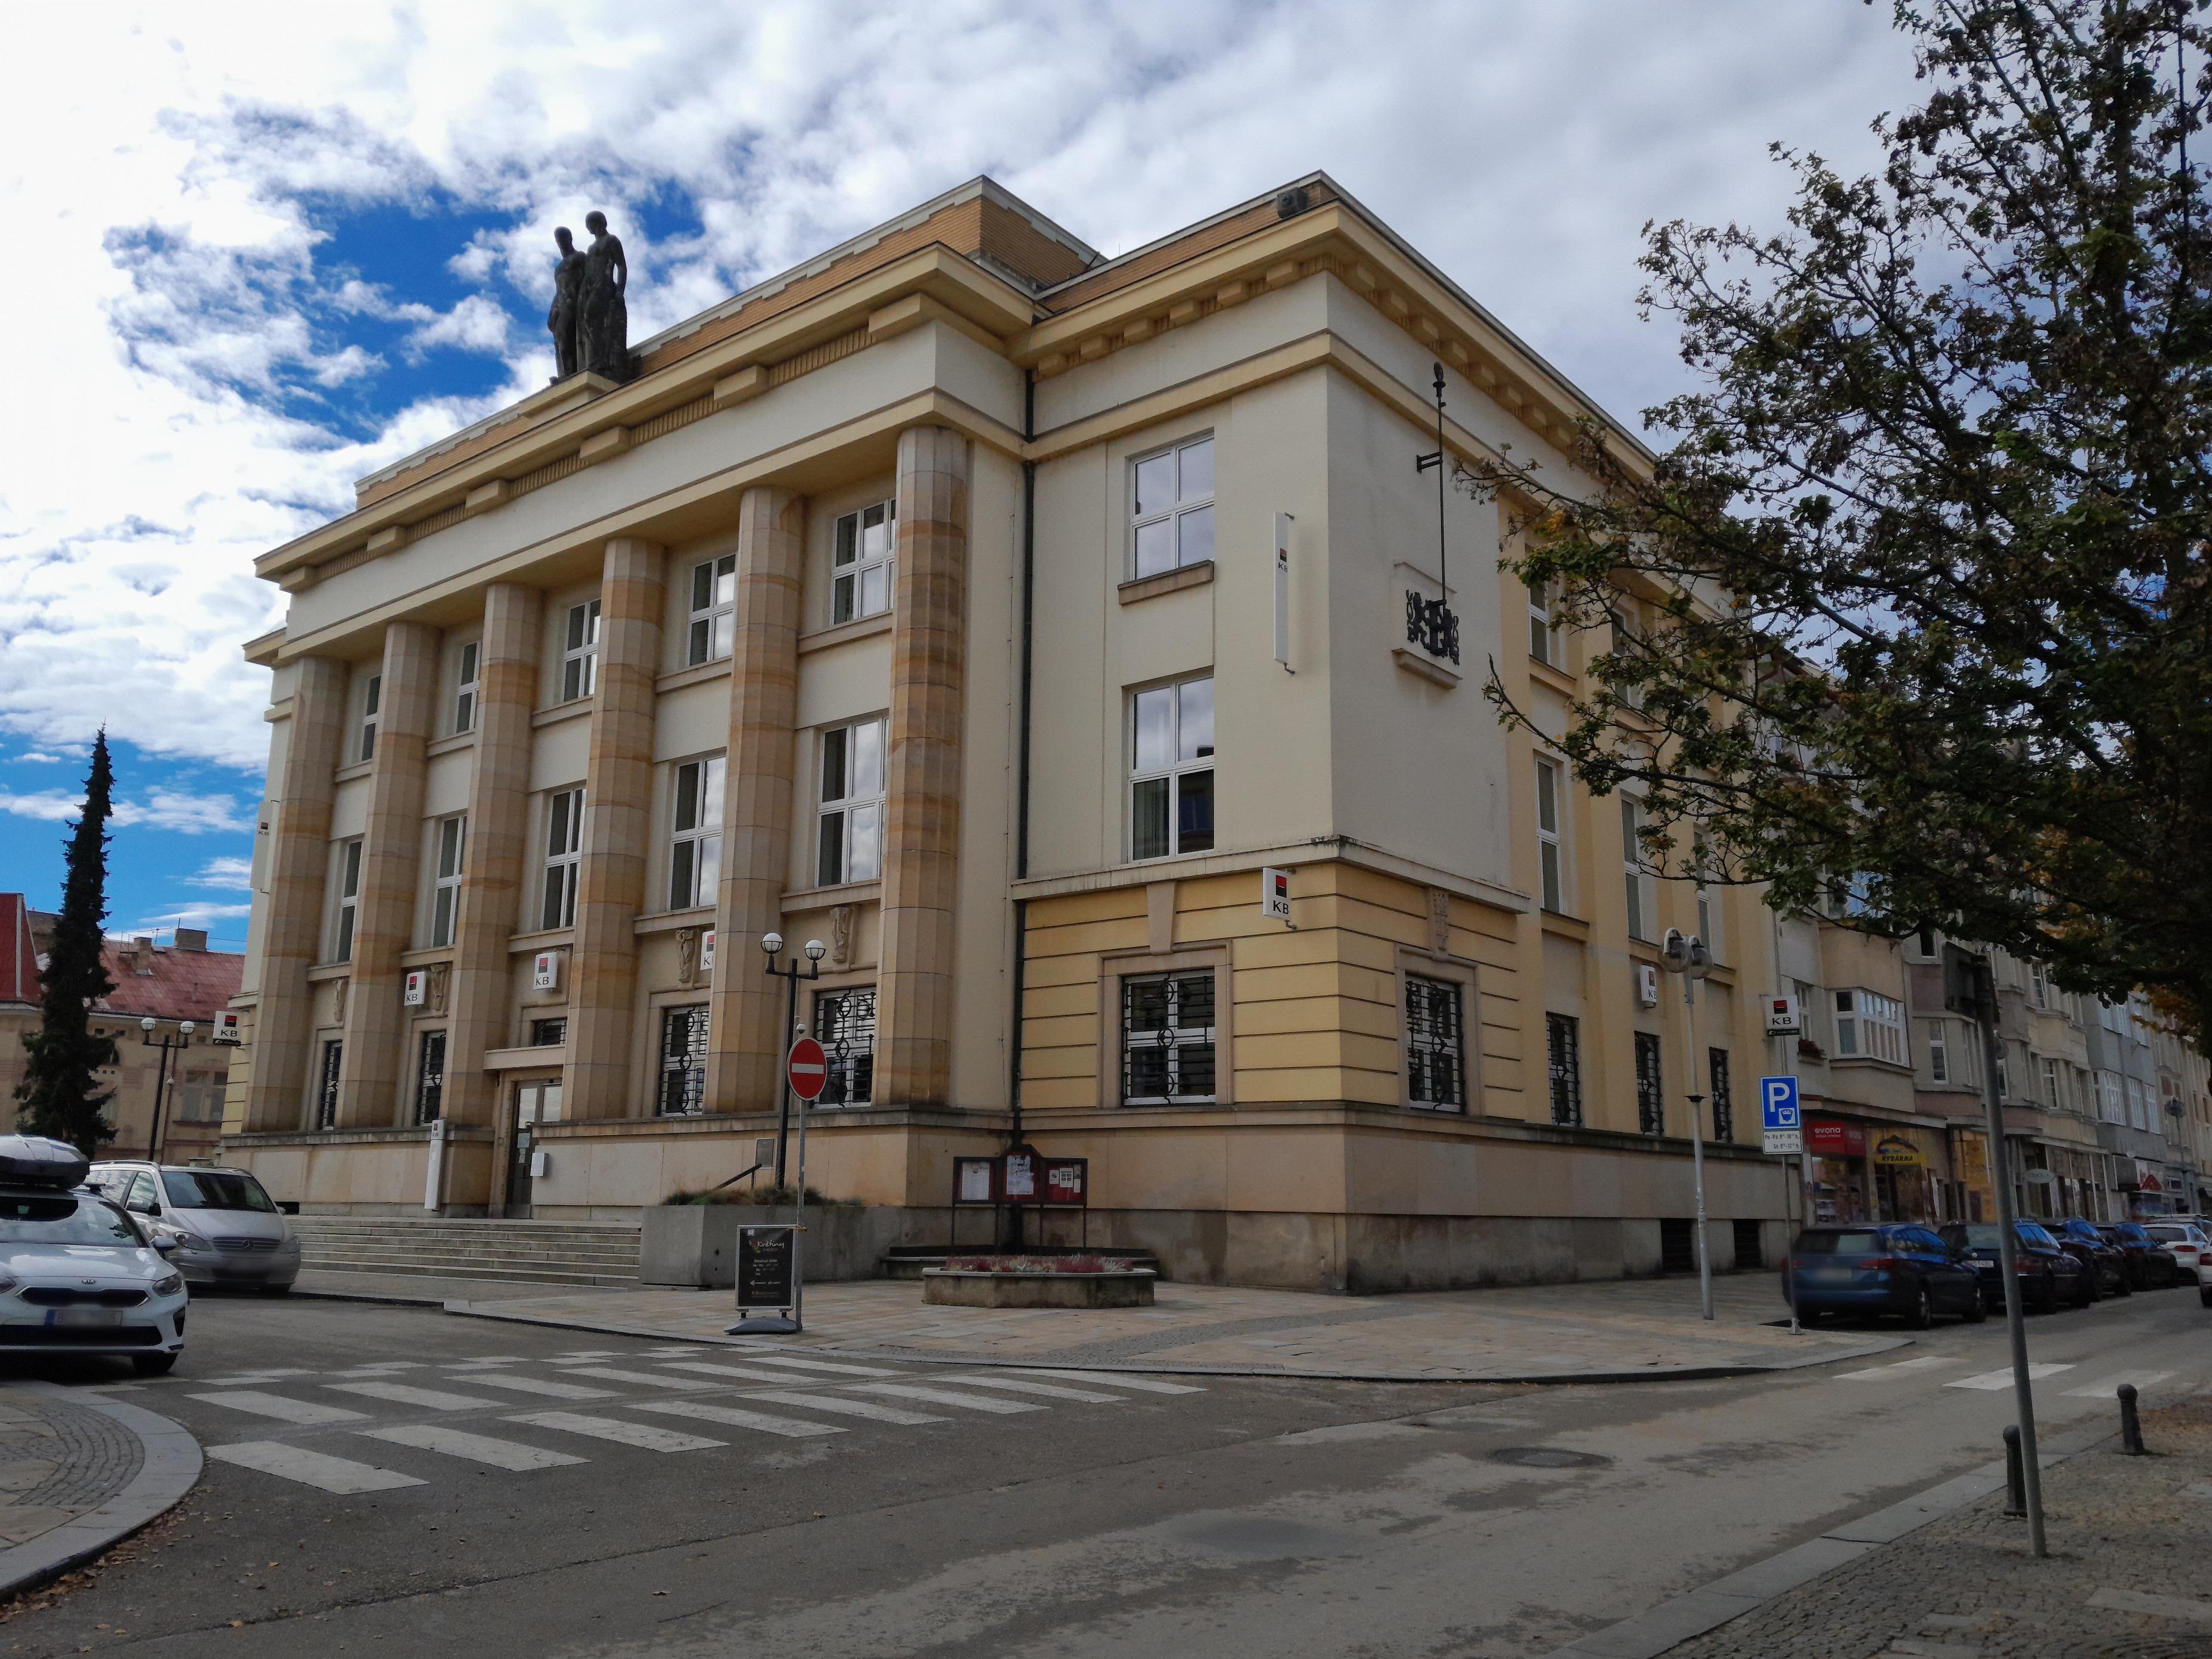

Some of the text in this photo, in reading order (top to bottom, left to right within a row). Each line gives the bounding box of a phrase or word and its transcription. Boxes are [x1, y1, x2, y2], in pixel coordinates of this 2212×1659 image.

[1273, 900, 1289, 915] KB
[704, 955, 714, 966] K
[536, 976, 549, 986] KB
[1648, 989, 1657, 1000] KB
[1772, 1016, 1792, 1025] KB
[1768, 1082, 1790, 1113] P
[757, 1240, 785, 1249] Květiny
